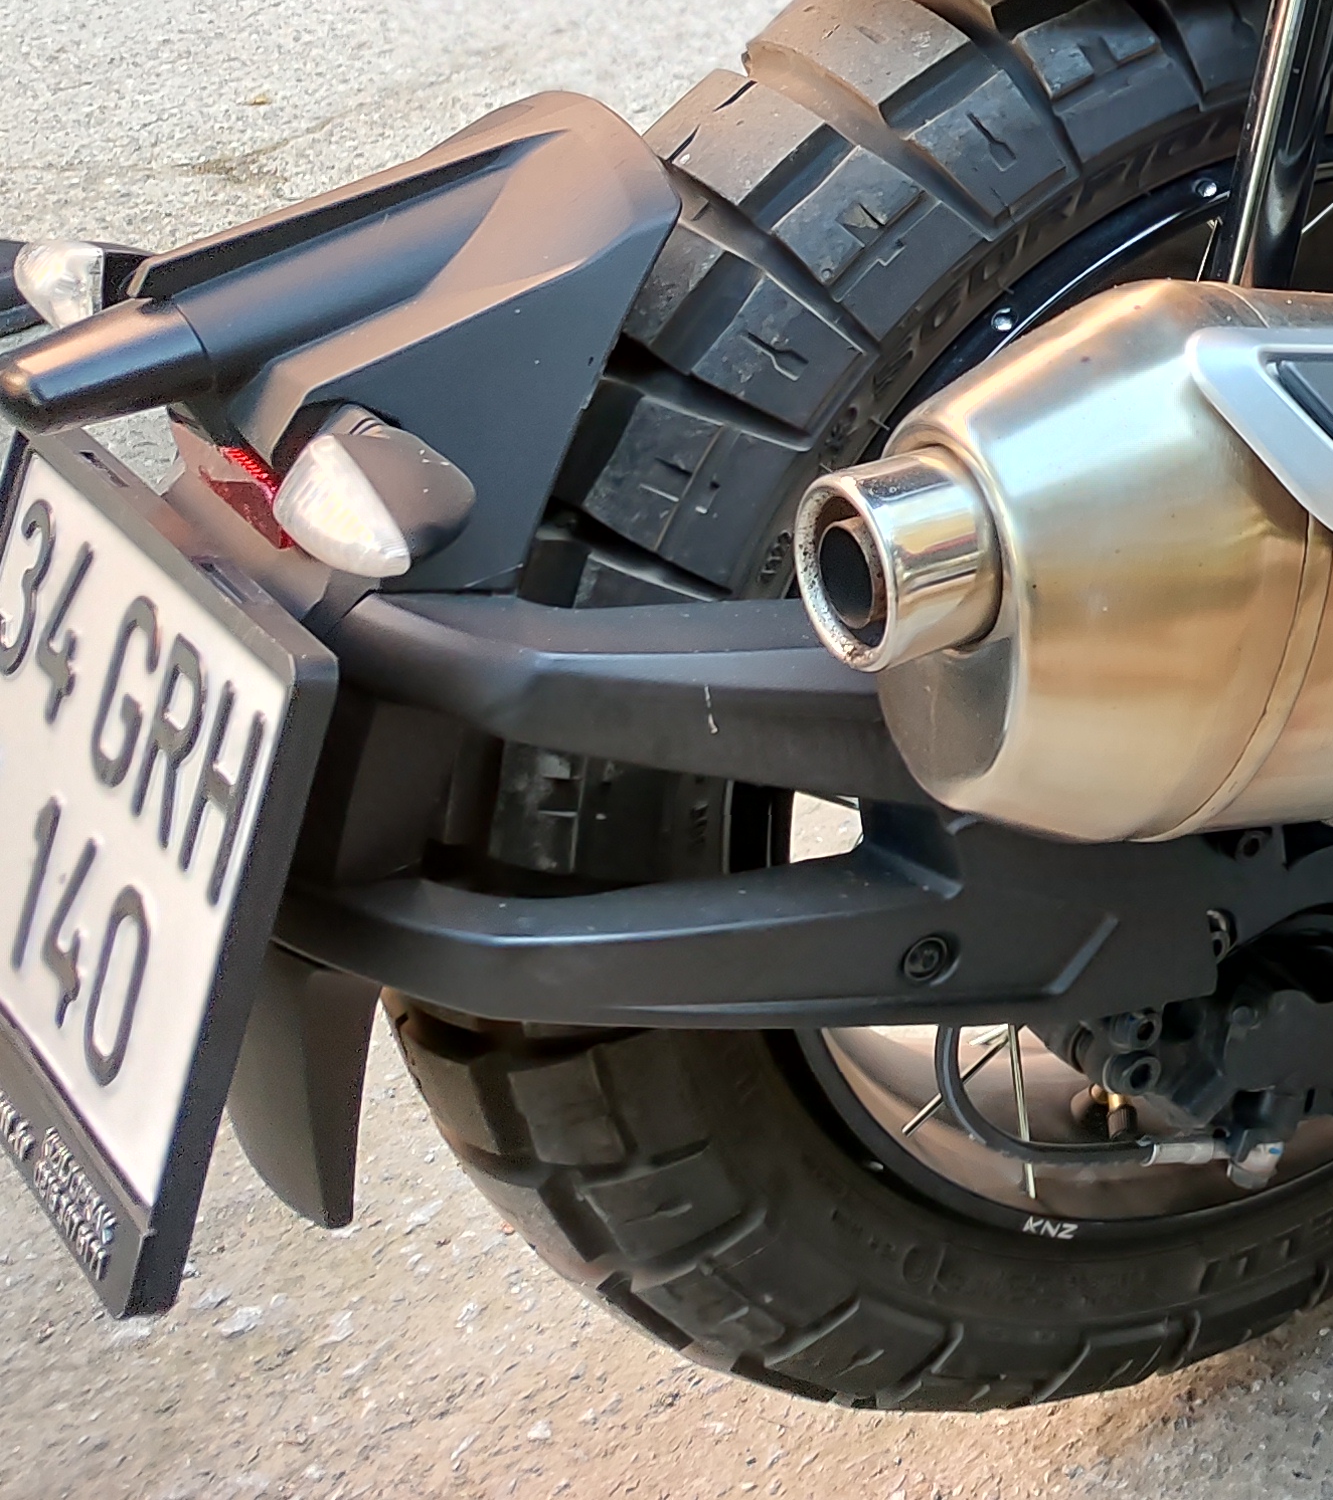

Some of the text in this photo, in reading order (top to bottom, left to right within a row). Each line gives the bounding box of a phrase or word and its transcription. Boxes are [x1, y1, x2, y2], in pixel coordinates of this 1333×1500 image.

[0, 498, 267, 908] 34 GRH
[10, 795, 152, 1088] 140
[1022, 1214, 1078, 1240] KNZ
